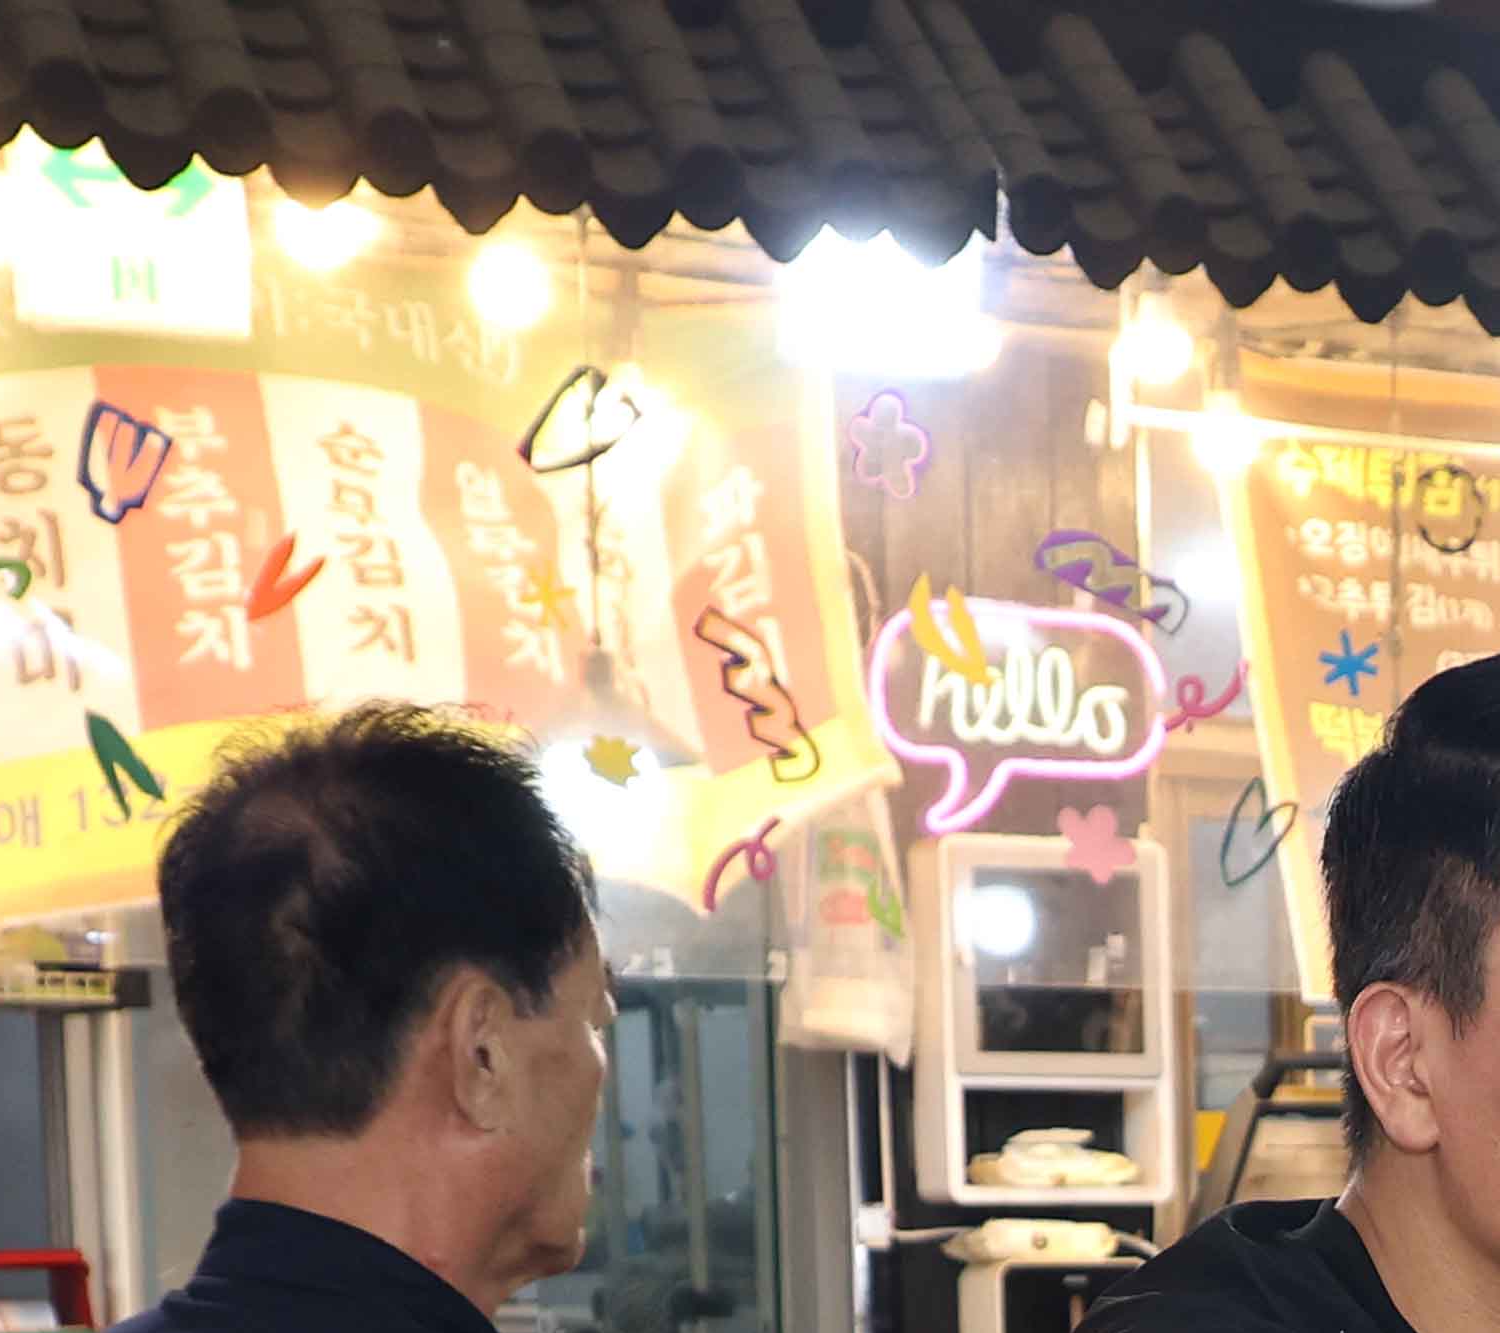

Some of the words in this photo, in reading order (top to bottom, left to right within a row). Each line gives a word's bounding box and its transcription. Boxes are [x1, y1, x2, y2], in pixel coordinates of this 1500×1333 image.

[150, 407, 255, 674] 부추김치
[317, 422, 418, 664] 순무김치
[918, 655, 1128, 758] hello
